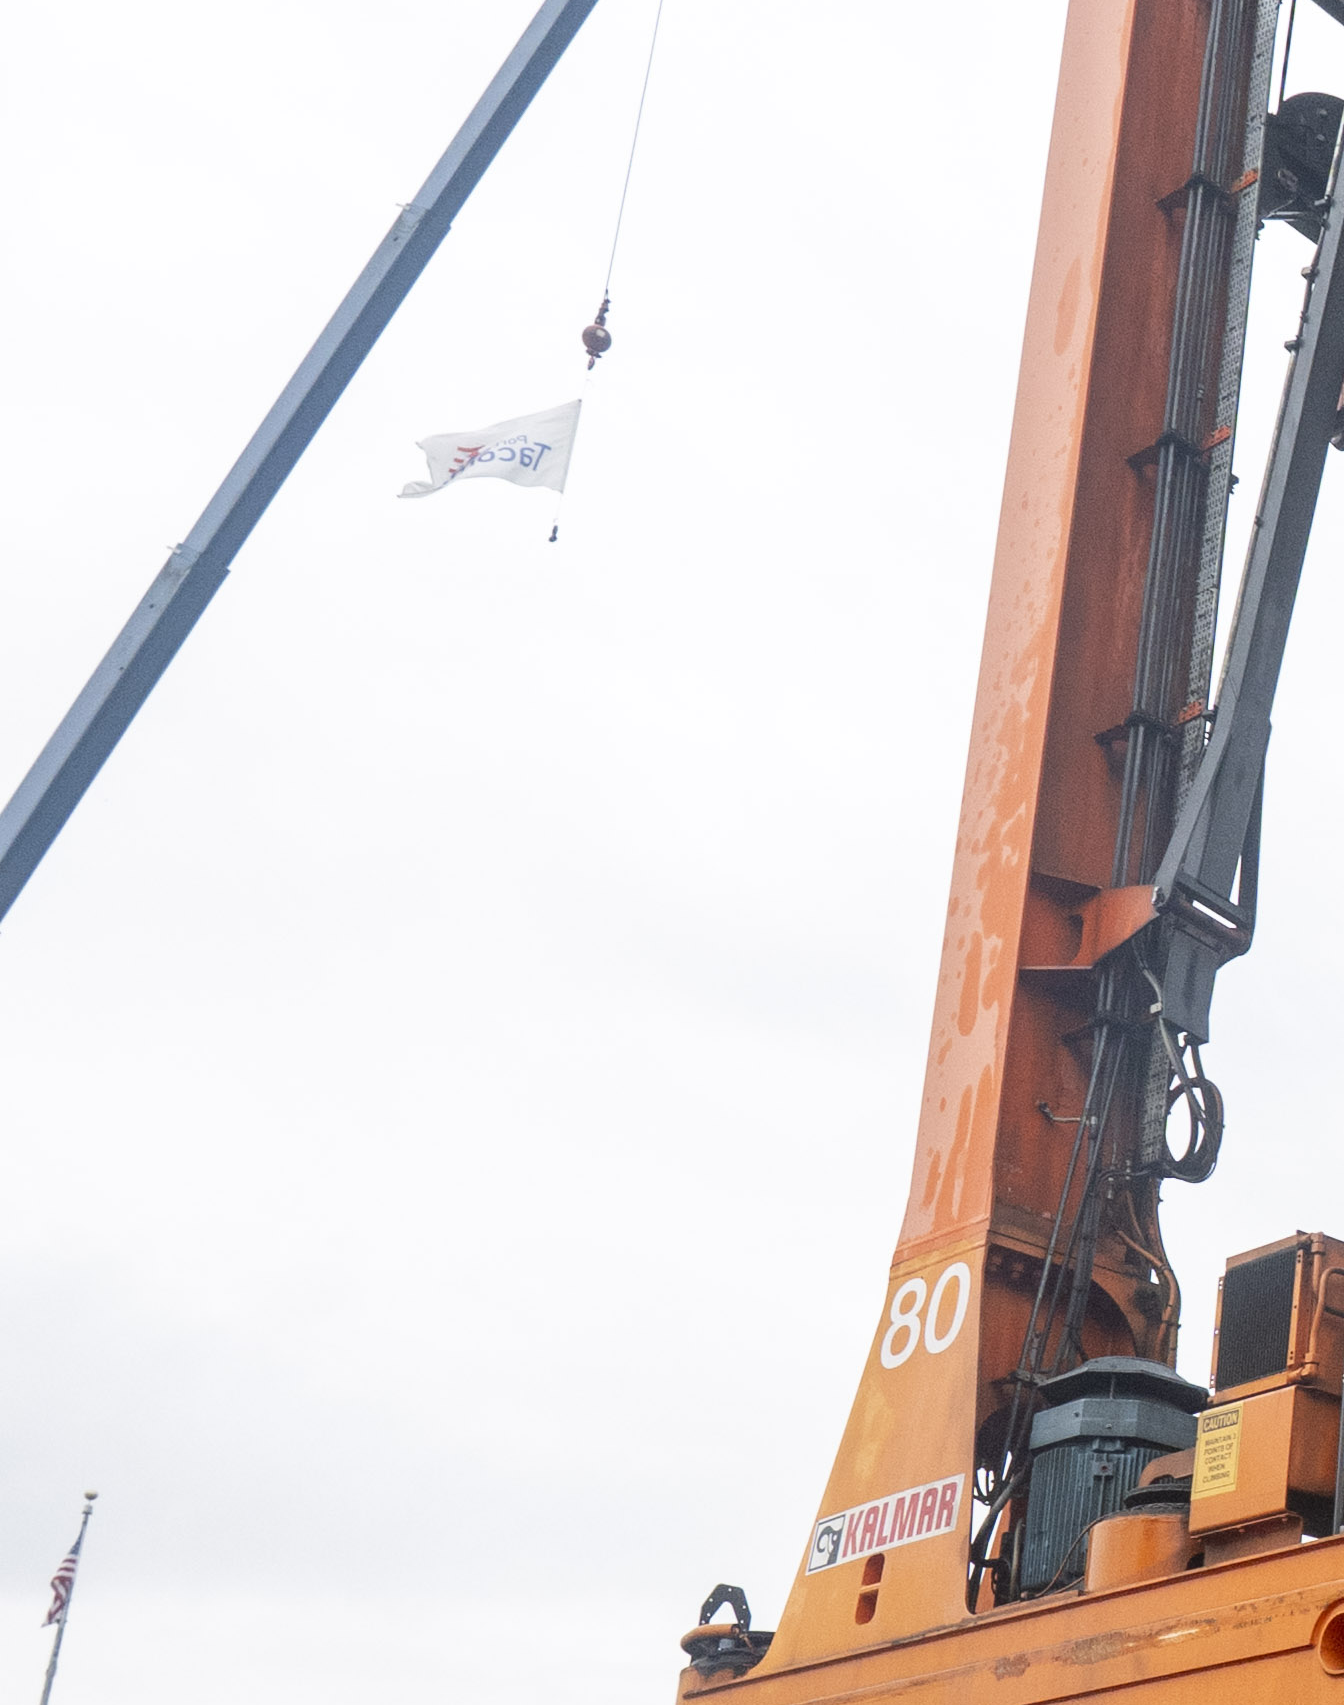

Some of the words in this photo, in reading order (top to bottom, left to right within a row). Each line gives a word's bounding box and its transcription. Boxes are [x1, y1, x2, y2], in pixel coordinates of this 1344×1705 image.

[880, 1262, 971, 1369] 80
[1204, 1411, 1238, 1431] CAUTION
[1205, 1435, 1231, 1446] MAINTAIN
[1204, 1445, 1224, 1455] POINTS
[1205, 1453, 1231, 1464] CONTACT
[842, 1480, 958, 1556] KALMAR
